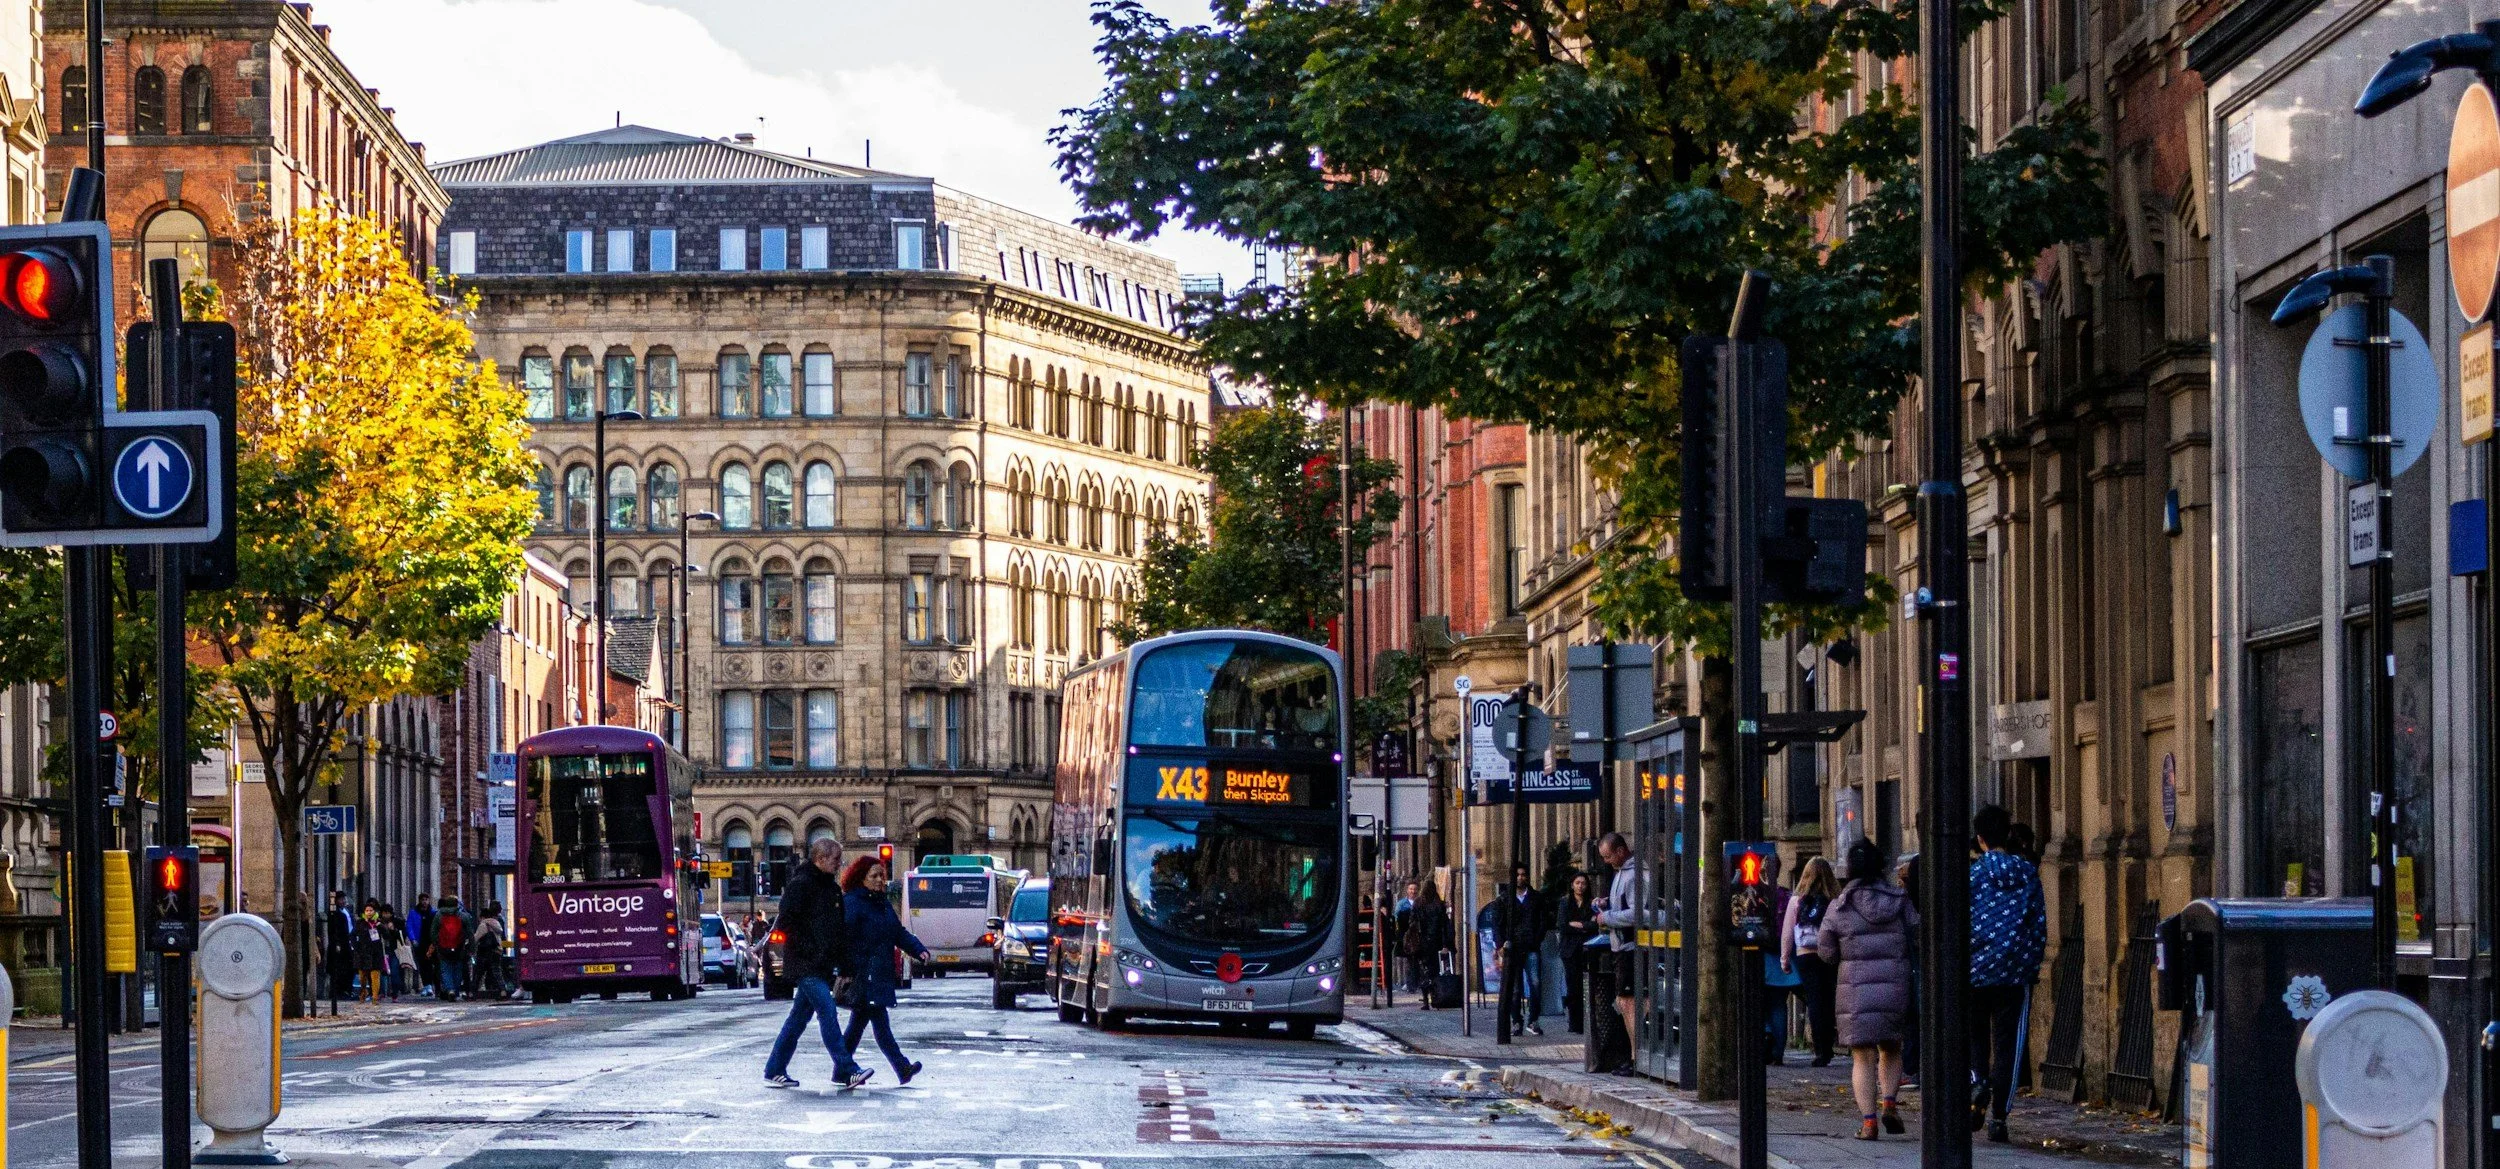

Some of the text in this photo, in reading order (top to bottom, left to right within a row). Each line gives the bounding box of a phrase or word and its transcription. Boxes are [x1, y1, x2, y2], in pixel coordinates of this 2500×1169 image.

[2464, 349, 2488, 383] Except
[2466, 393, 2487, 421] trams
[2351, 496, 2375, 522] Except
[2353, 530, 2373, 552] trams
[1456, 679, 1470, 690] SG
[1157, 766, 1209, 801] X43
[1226, 769, 1290, 792] Burnley
[1571, 778, 1591, 786] HOTEL
[1223, 787, 1290, 803] then Skipton
[542, 875, 565, 884] 39260
[547, 892, 644, 917] Vantage
[625, 925, 658, 933] Manchester
[1207, 1000, 1249, 1010] BF63 HCL
